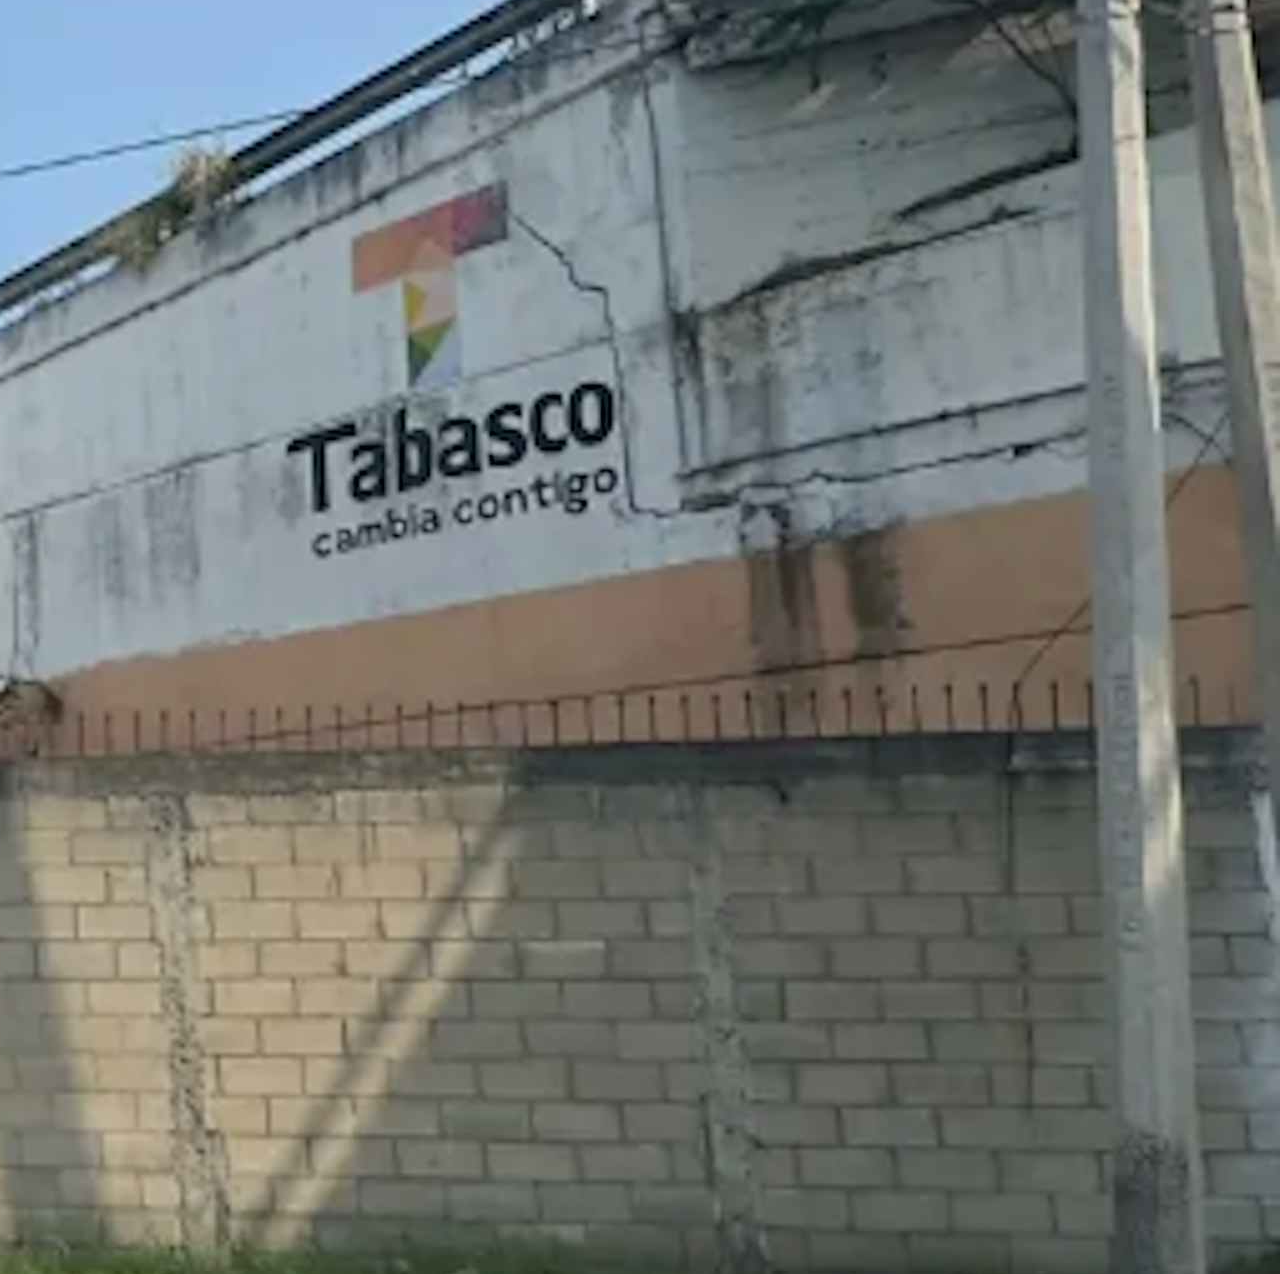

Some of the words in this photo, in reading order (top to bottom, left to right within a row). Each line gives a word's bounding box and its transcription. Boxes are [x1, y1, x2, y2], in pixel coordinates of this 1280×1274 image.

[286, 381, 614, 513] Tabasco
[311, 503, 441, 559] cambia
[452, 465, 619, 525] contigo
